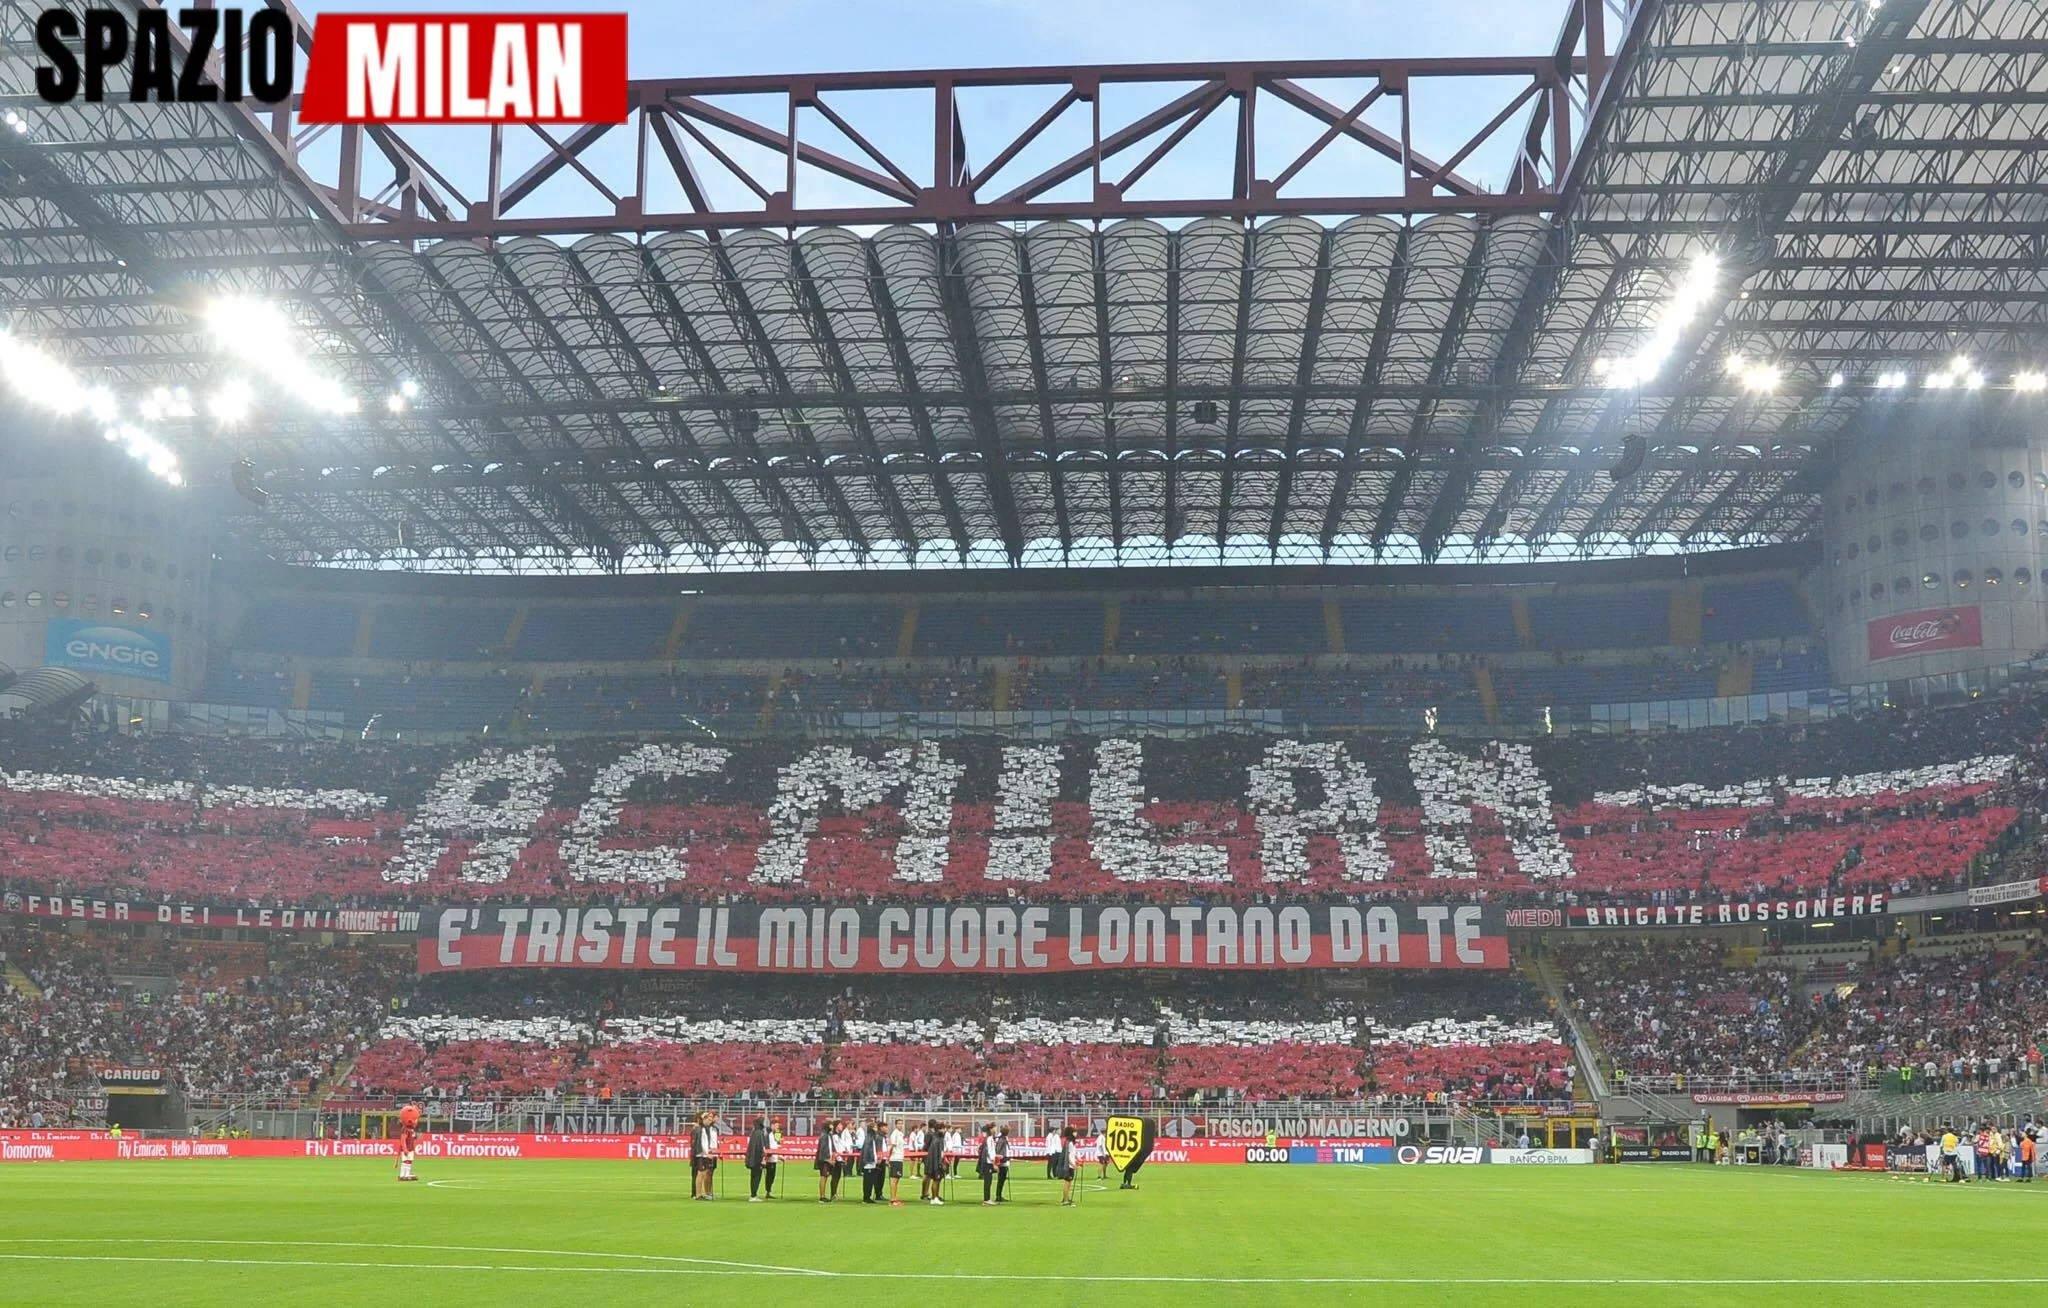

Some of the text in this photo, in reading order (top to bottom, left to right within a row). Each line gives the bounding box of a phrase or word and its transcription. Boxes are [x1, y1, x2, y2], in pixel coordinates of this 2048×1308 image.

[747, 739, 1575, 884] MILAN
[28, 896, 331, 928] FOSSA DEI LEONI
[1506, 909, 1562, 927] MEDI
[1586, 894, 1884, 926] BRIGATE ROSSONERE
[438, 906, 1485, 968] E' TRISTE IL MIO CUORE LONTANO DA TE
[104, 1069, 161, 1080] CARUGO
[1208, 1117, 1410, 1137] TOSCOLANO MADERNO
[118, 1141, 131, 1159] Fly
[172, 1140, 190, 1156] Hello
[306, 1141, 328, 1157] Fly
[415, 1141, 440, 1156] ello
[441, 1141, 522, 1156] Tomorrow.
[1109, 1129, 1138, 1152] 105
[629, 1143, 651, 1159] Fly
[1247, 1149, 1288, 1162] 00:00
[1334, 1149, 1363, 1162] TIM
[1510, 1155, 1567, 1164] BANCO BPM
